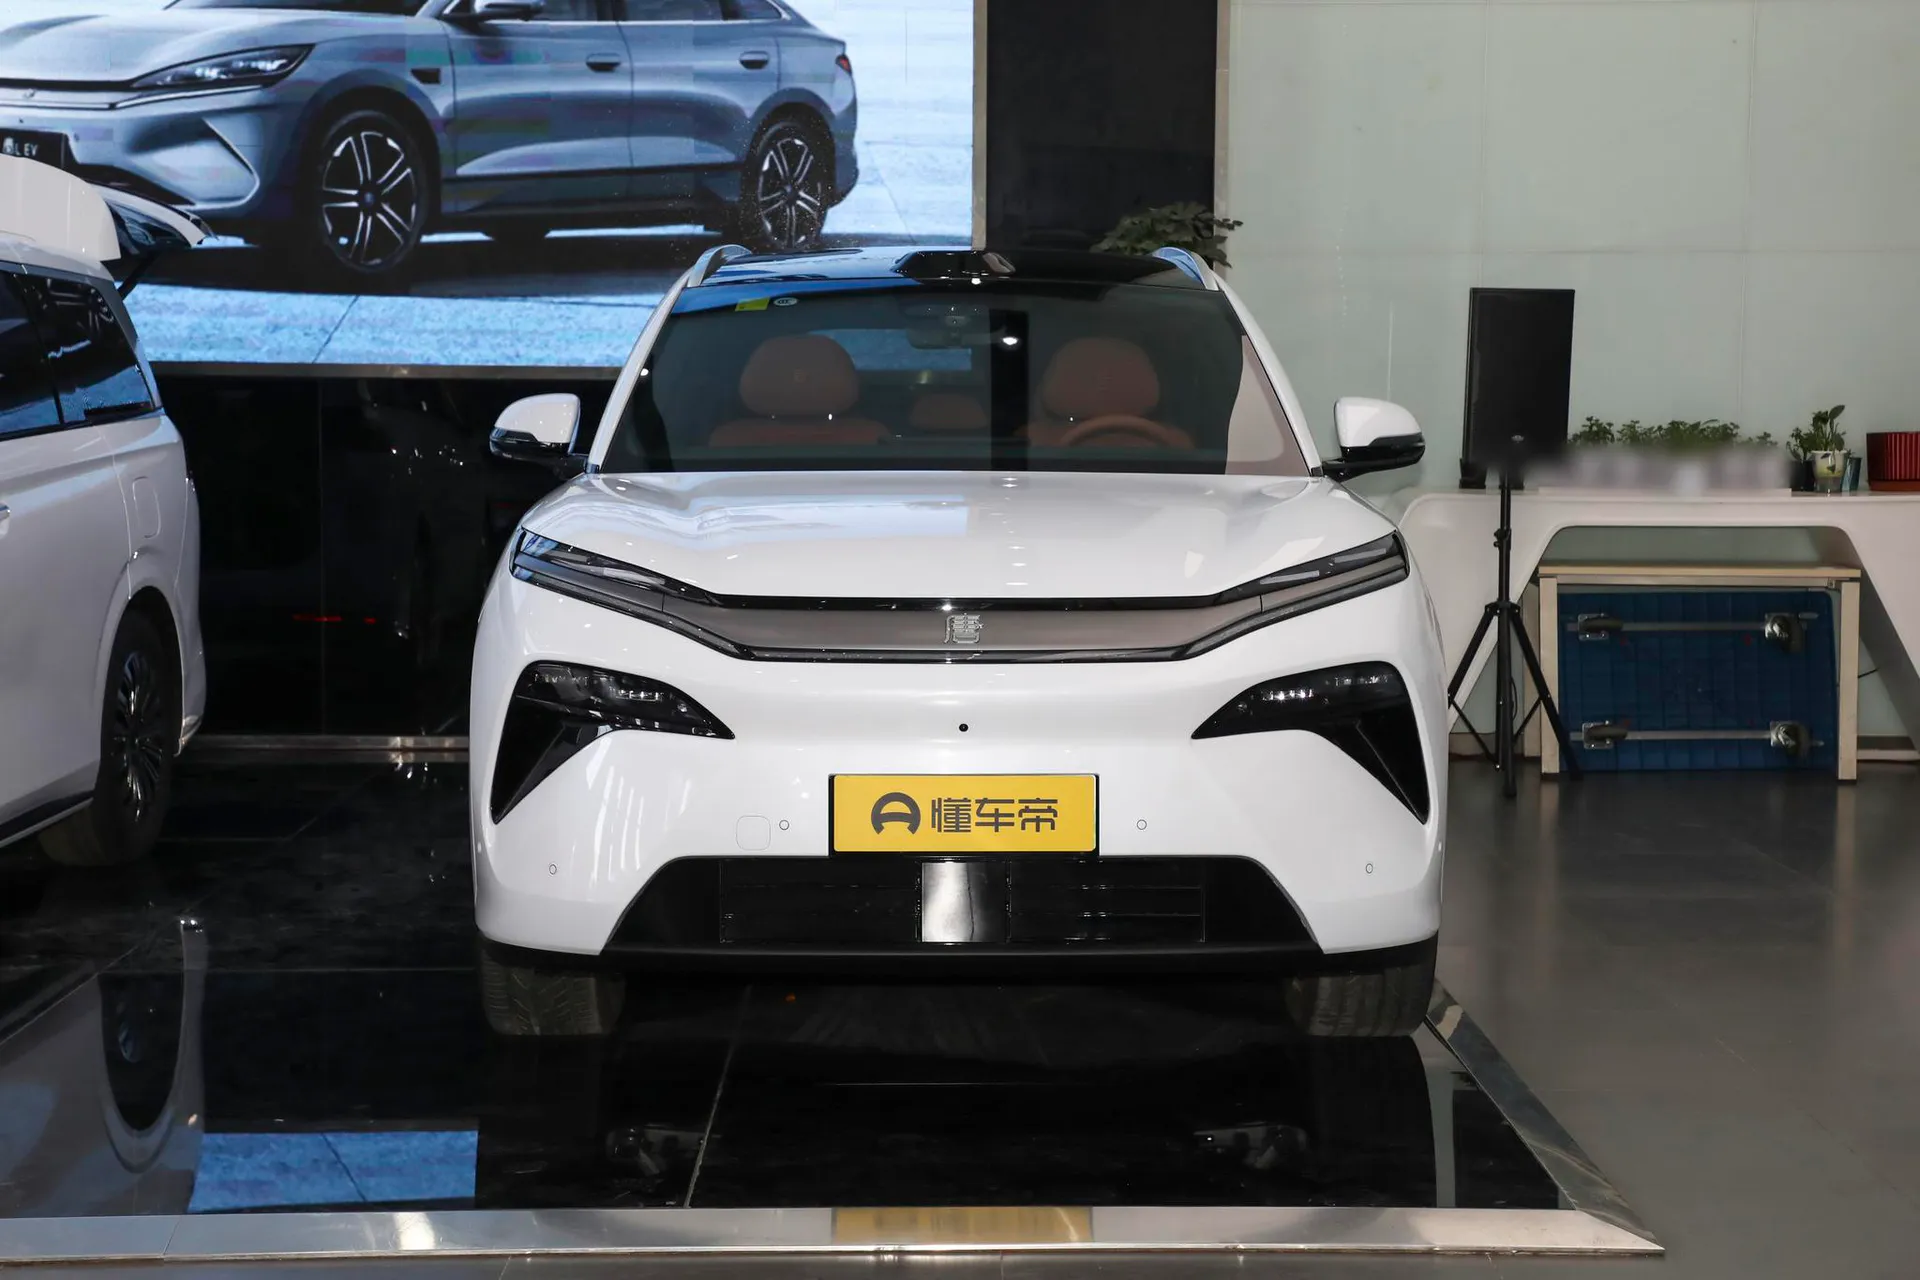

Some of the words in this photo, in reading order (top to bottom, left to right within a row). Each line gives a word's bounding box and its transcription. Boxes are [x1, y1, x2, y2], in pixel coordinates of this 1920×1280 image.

[24, 143, 38, 156] EV
[931, 797, 1058, 833] 懂车帝
